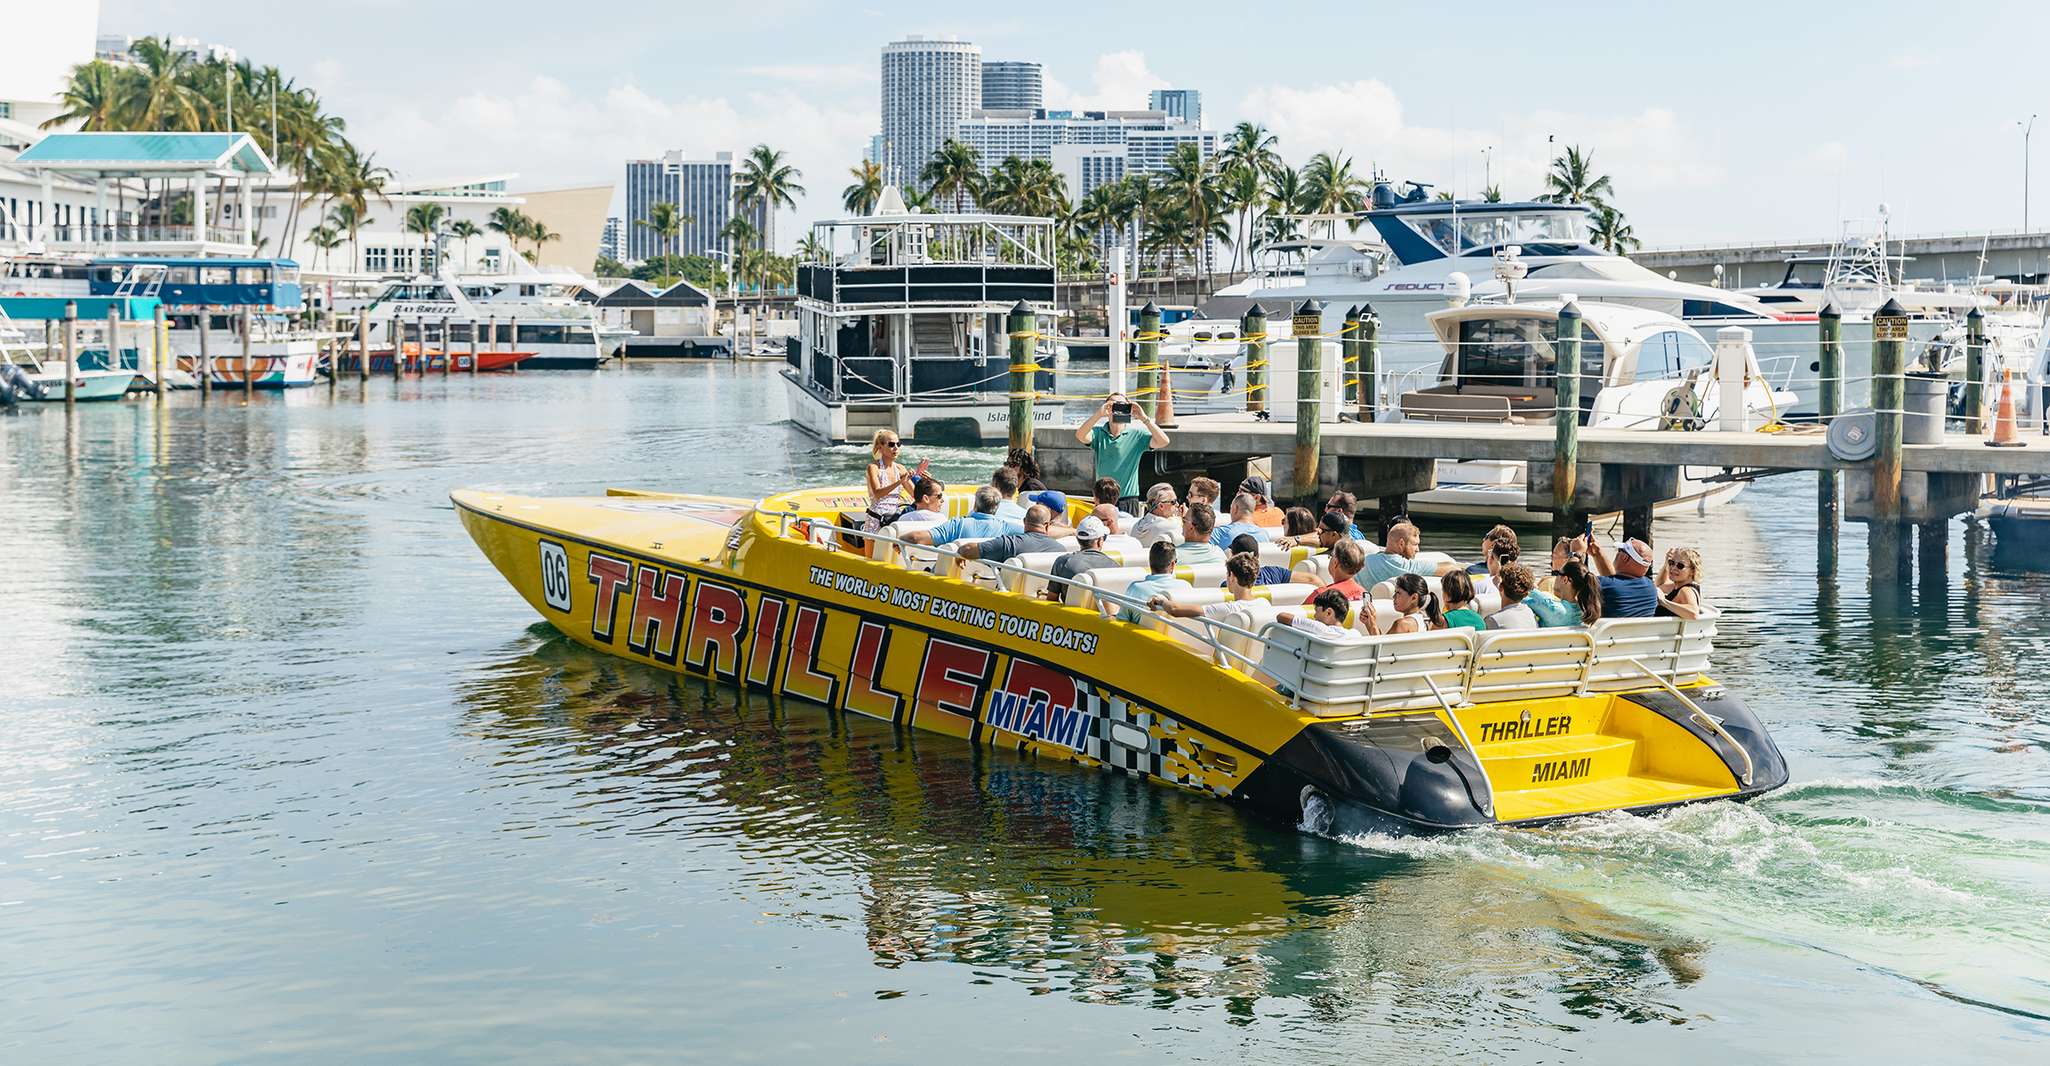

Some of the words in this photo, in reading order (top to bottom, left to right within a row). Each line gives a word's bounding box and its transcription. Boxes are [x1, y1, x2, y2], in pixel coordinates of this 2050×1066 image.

[394, 304, 413, 313] BAY
[416, 305, 457, 313] BREEZE
[987, 412, 1011, 422] Isla
[1033, 411, 1053, 421] ind
[544, 549, 567, 602] 06
[810, 565, 834, 588] THE
[835, 572, 890, 603] WORLD'S
[890, 586, 930, 613] MOST
[930, 597, 996, 630] EXCITING
[998, 613, 1041, 641] TOUR
[1040, 624, 1099, 655] BOATS!
[588, 551, 1079, 752] THRILLER
[985, 688, 1093, 753] MIAMI
[1480, 716, 1572, 743] THRILLER
[1531, 757, 1592, 783] MIAMI
